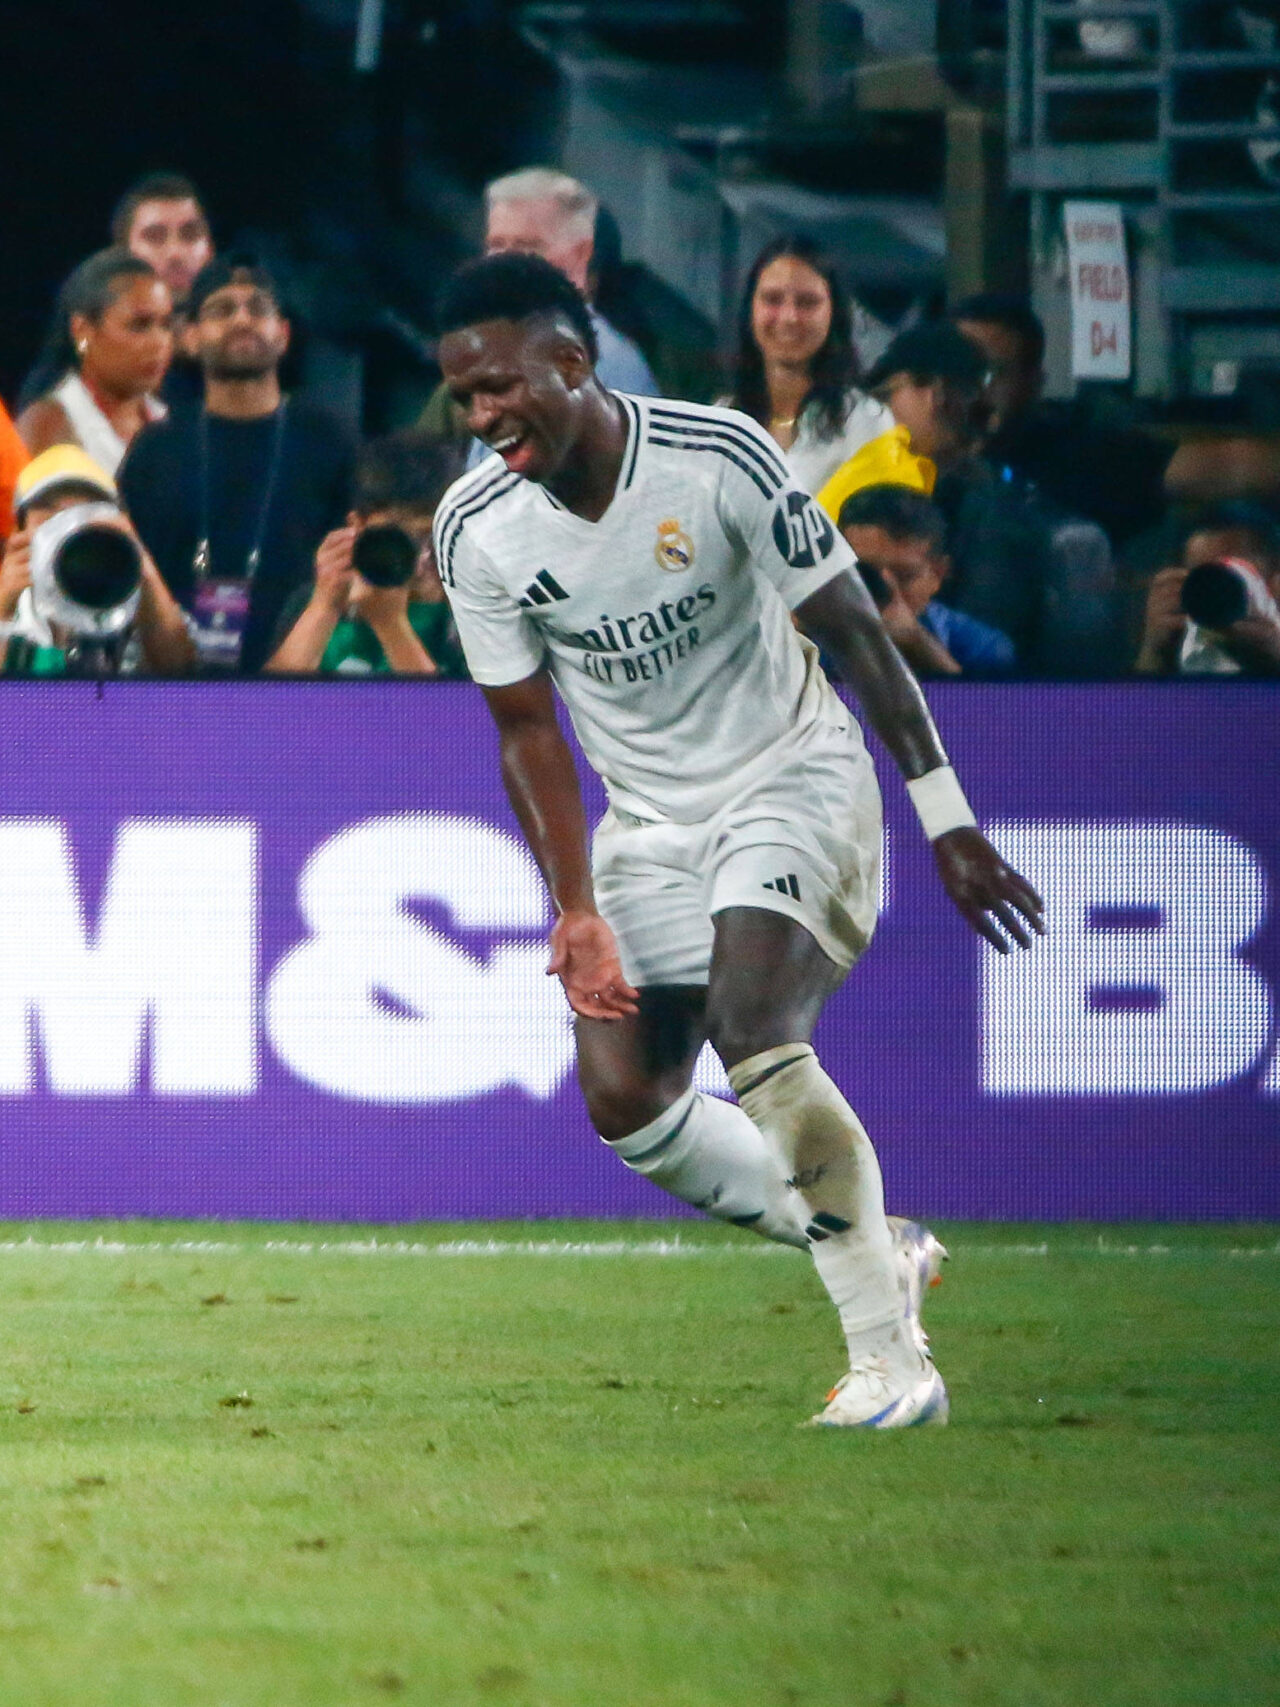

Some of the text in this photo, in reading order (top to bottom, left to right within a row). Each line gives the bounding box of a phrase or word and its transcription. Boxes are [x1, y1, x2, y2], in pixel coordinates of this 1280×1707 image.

[773, 491, 835, 569] hp
[558, 582, 717, 652] mirates
[582, 625, 701, 684] FLY BETTER
[977, 816, 1280, 1098] B
